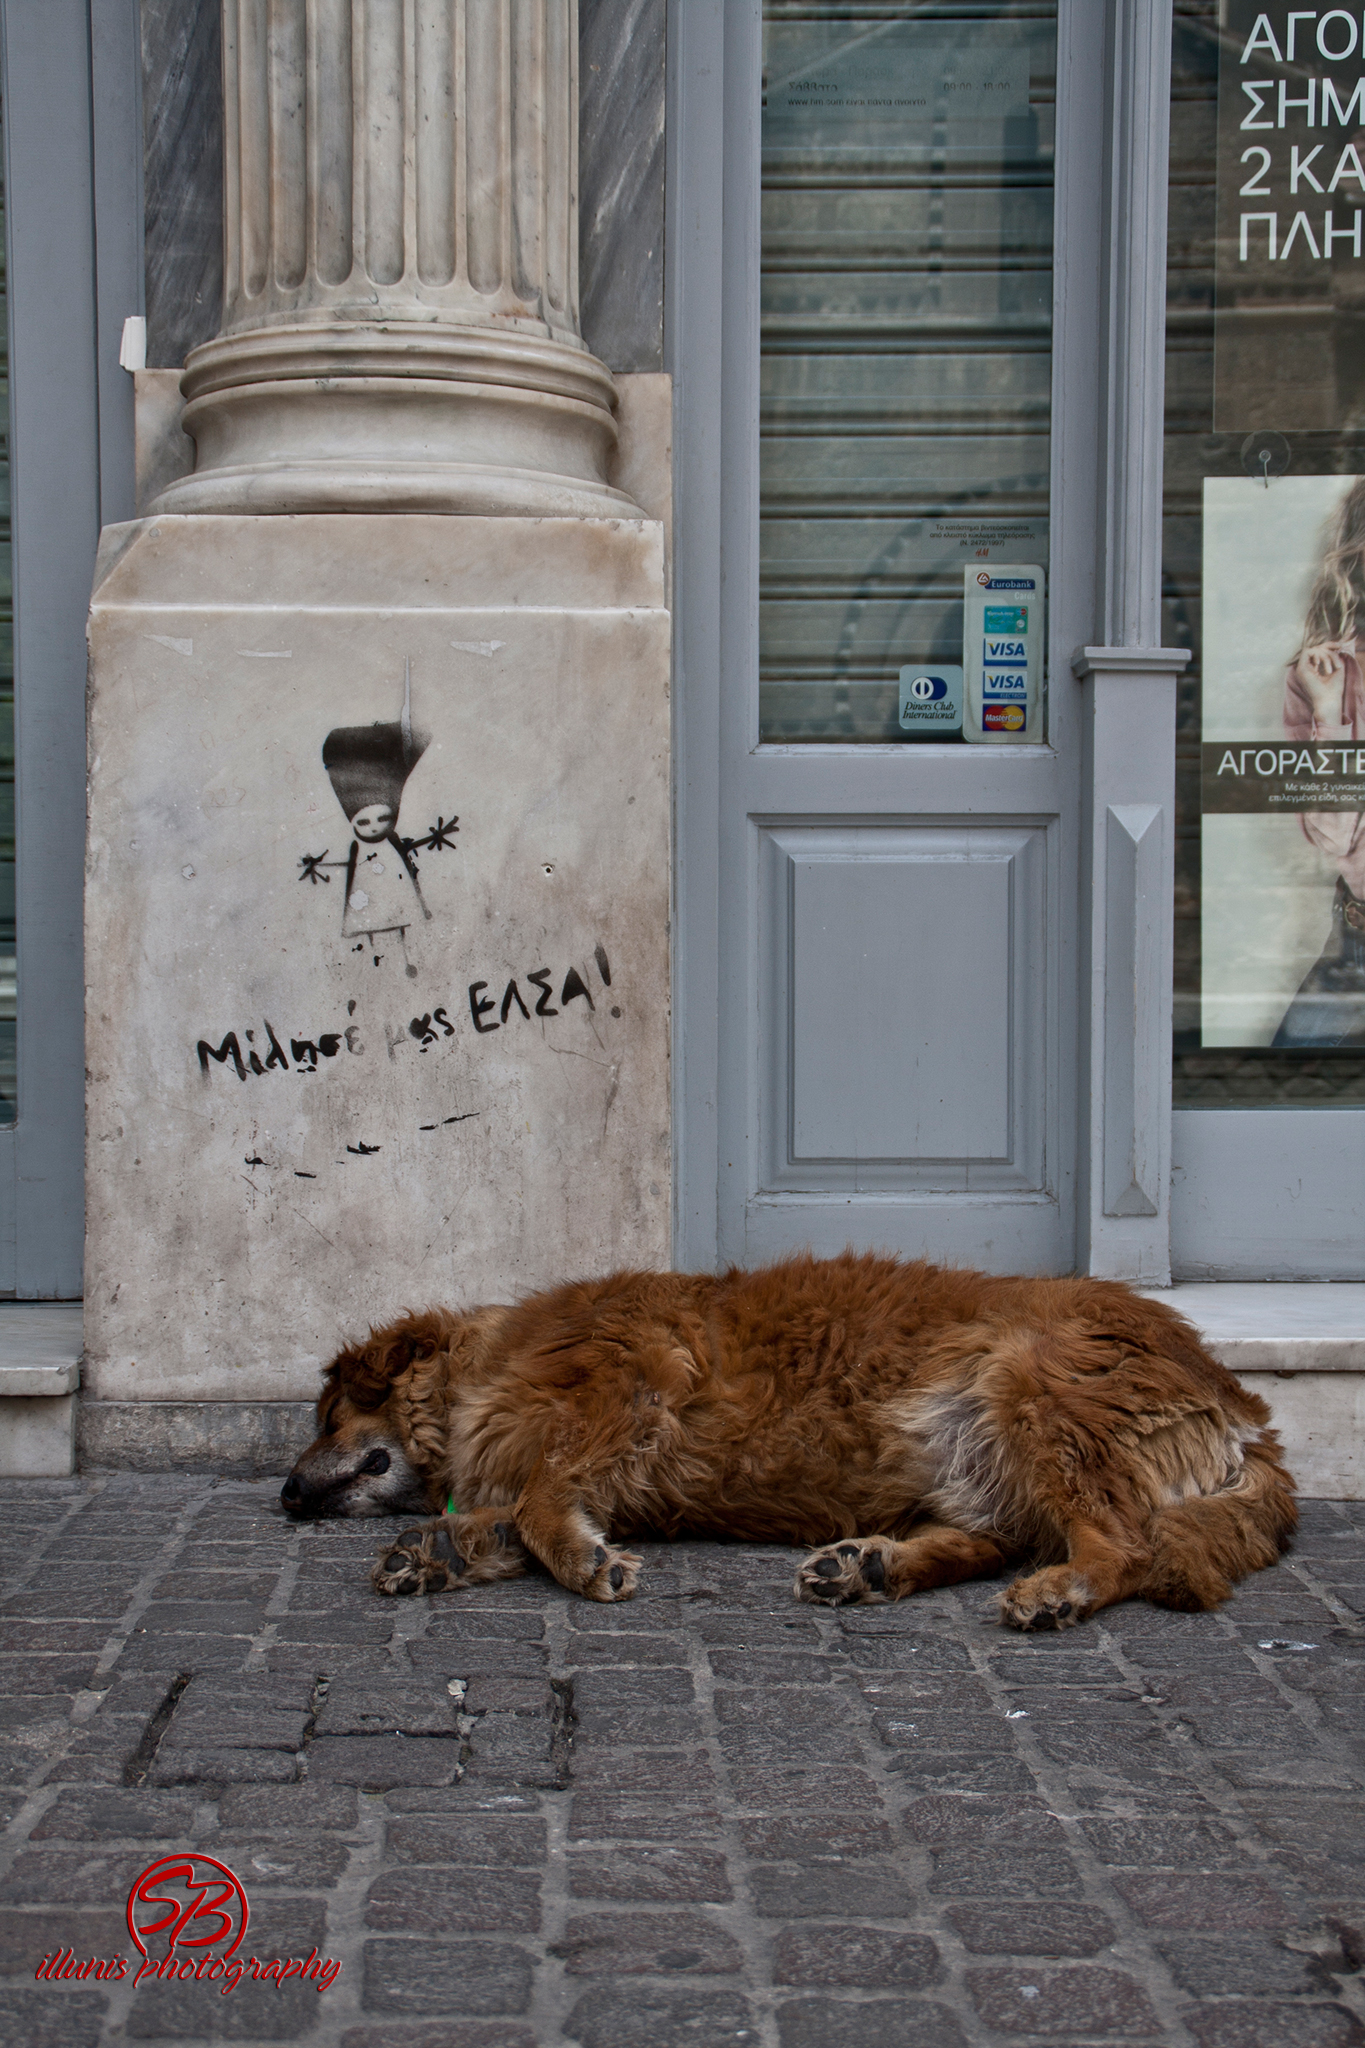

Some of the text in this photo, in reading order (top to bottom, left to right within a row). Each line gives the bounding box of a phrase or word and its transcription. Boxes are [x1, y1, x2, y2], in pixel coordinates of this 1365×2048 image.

[1240, 10, 1365, 64] ΑΓΟ
[1239, 146, 1271, 196] 2
[1239, 209, 1362, 261] ΠΛΗ
[991, 580, 1032, 588] Eurobank
[1014, 592, 1036, 600] Cards
[988, 643, 1025, 656] VISA
[987, 675, 1024, 688] VISA
[905, 701, 954, 711] Diners Club
[902, 710, 956, 720] International
[985, 714, 1024, 722] MasterCard
[1217, 749, 1365, 776] ΑΓΟΡΑΣΤΕ
[1285, 783, 1298, 791] Με
[1300, 782, 1321, 791] κάθε
[1322, 782, 1329, 791] 2
[1268, 793, 1317, 803] επιλεγμένα
[1340, 794, 1357, 802] σας
[468, 941, 621, 1033] ΕΛΣΑ!
